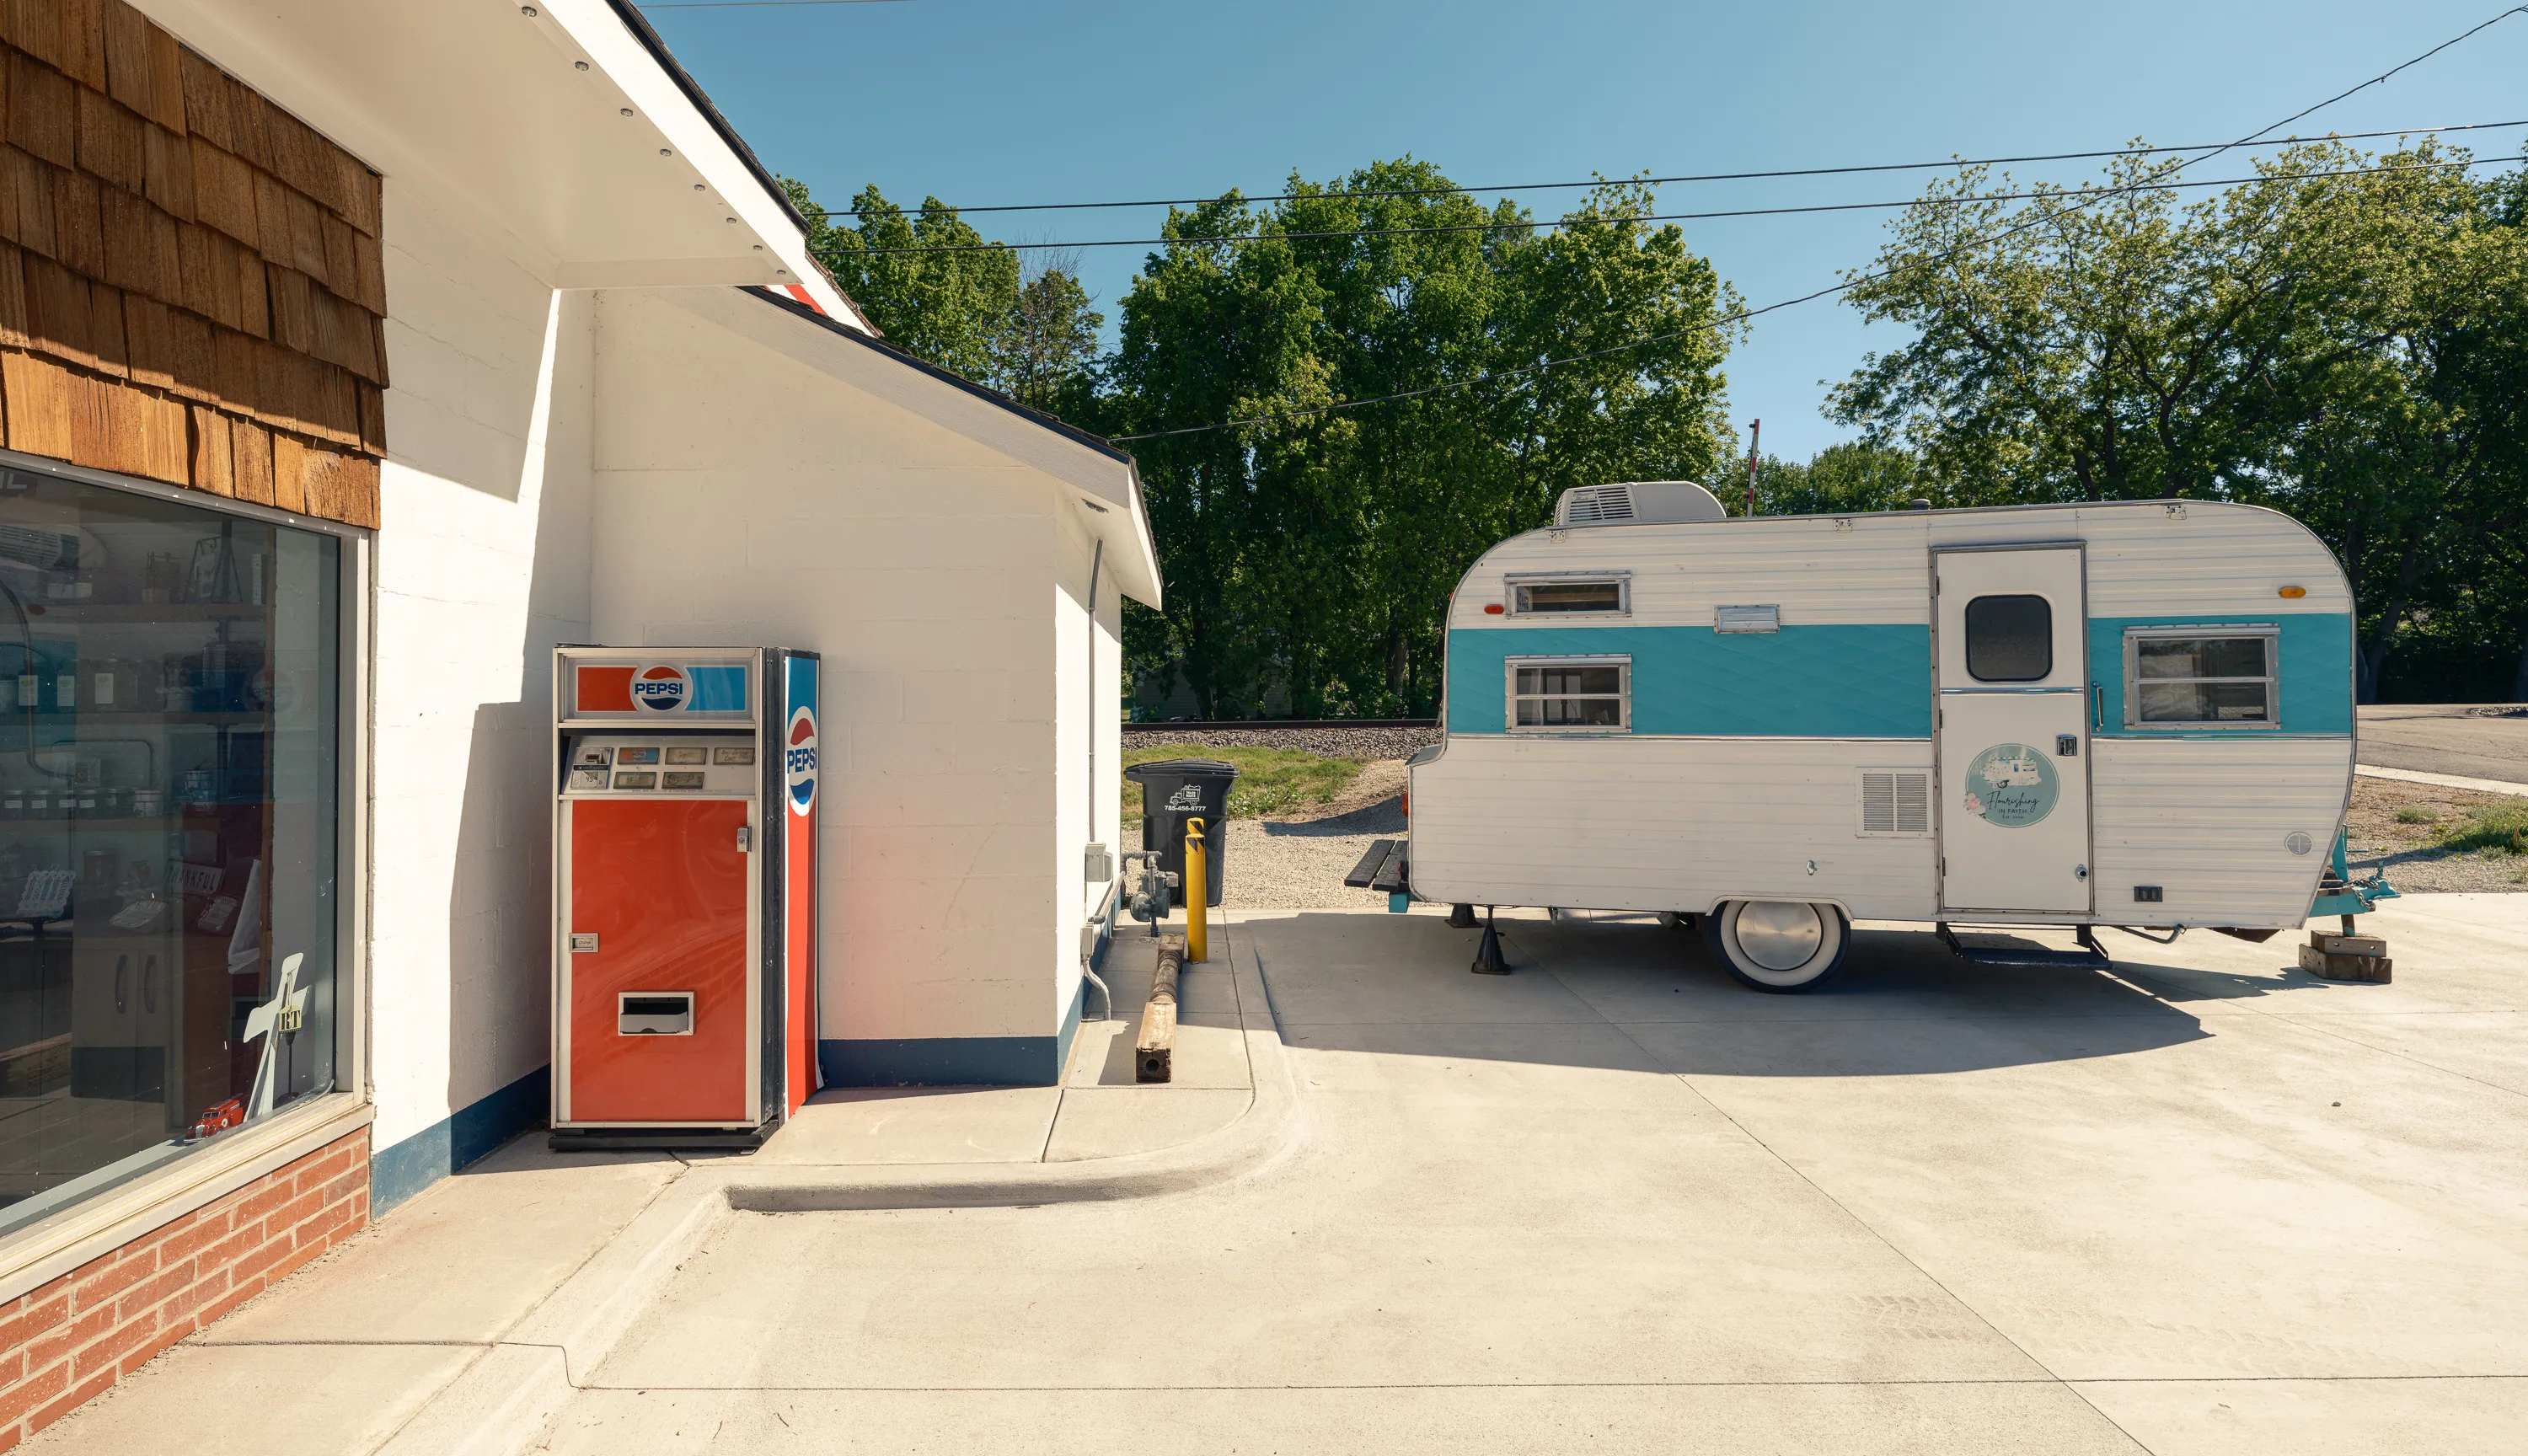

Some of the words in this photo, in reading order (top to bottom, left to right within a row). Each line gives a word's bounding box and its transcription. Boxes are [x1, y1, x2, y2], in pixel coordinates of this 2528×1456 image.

[635, 682, 683, 695] PEPSI
[786, 747, 817, 774] PEPSI
[1986, 790, 2039, 813] Flourishing
[281, 1009, 301, 1030] RT
